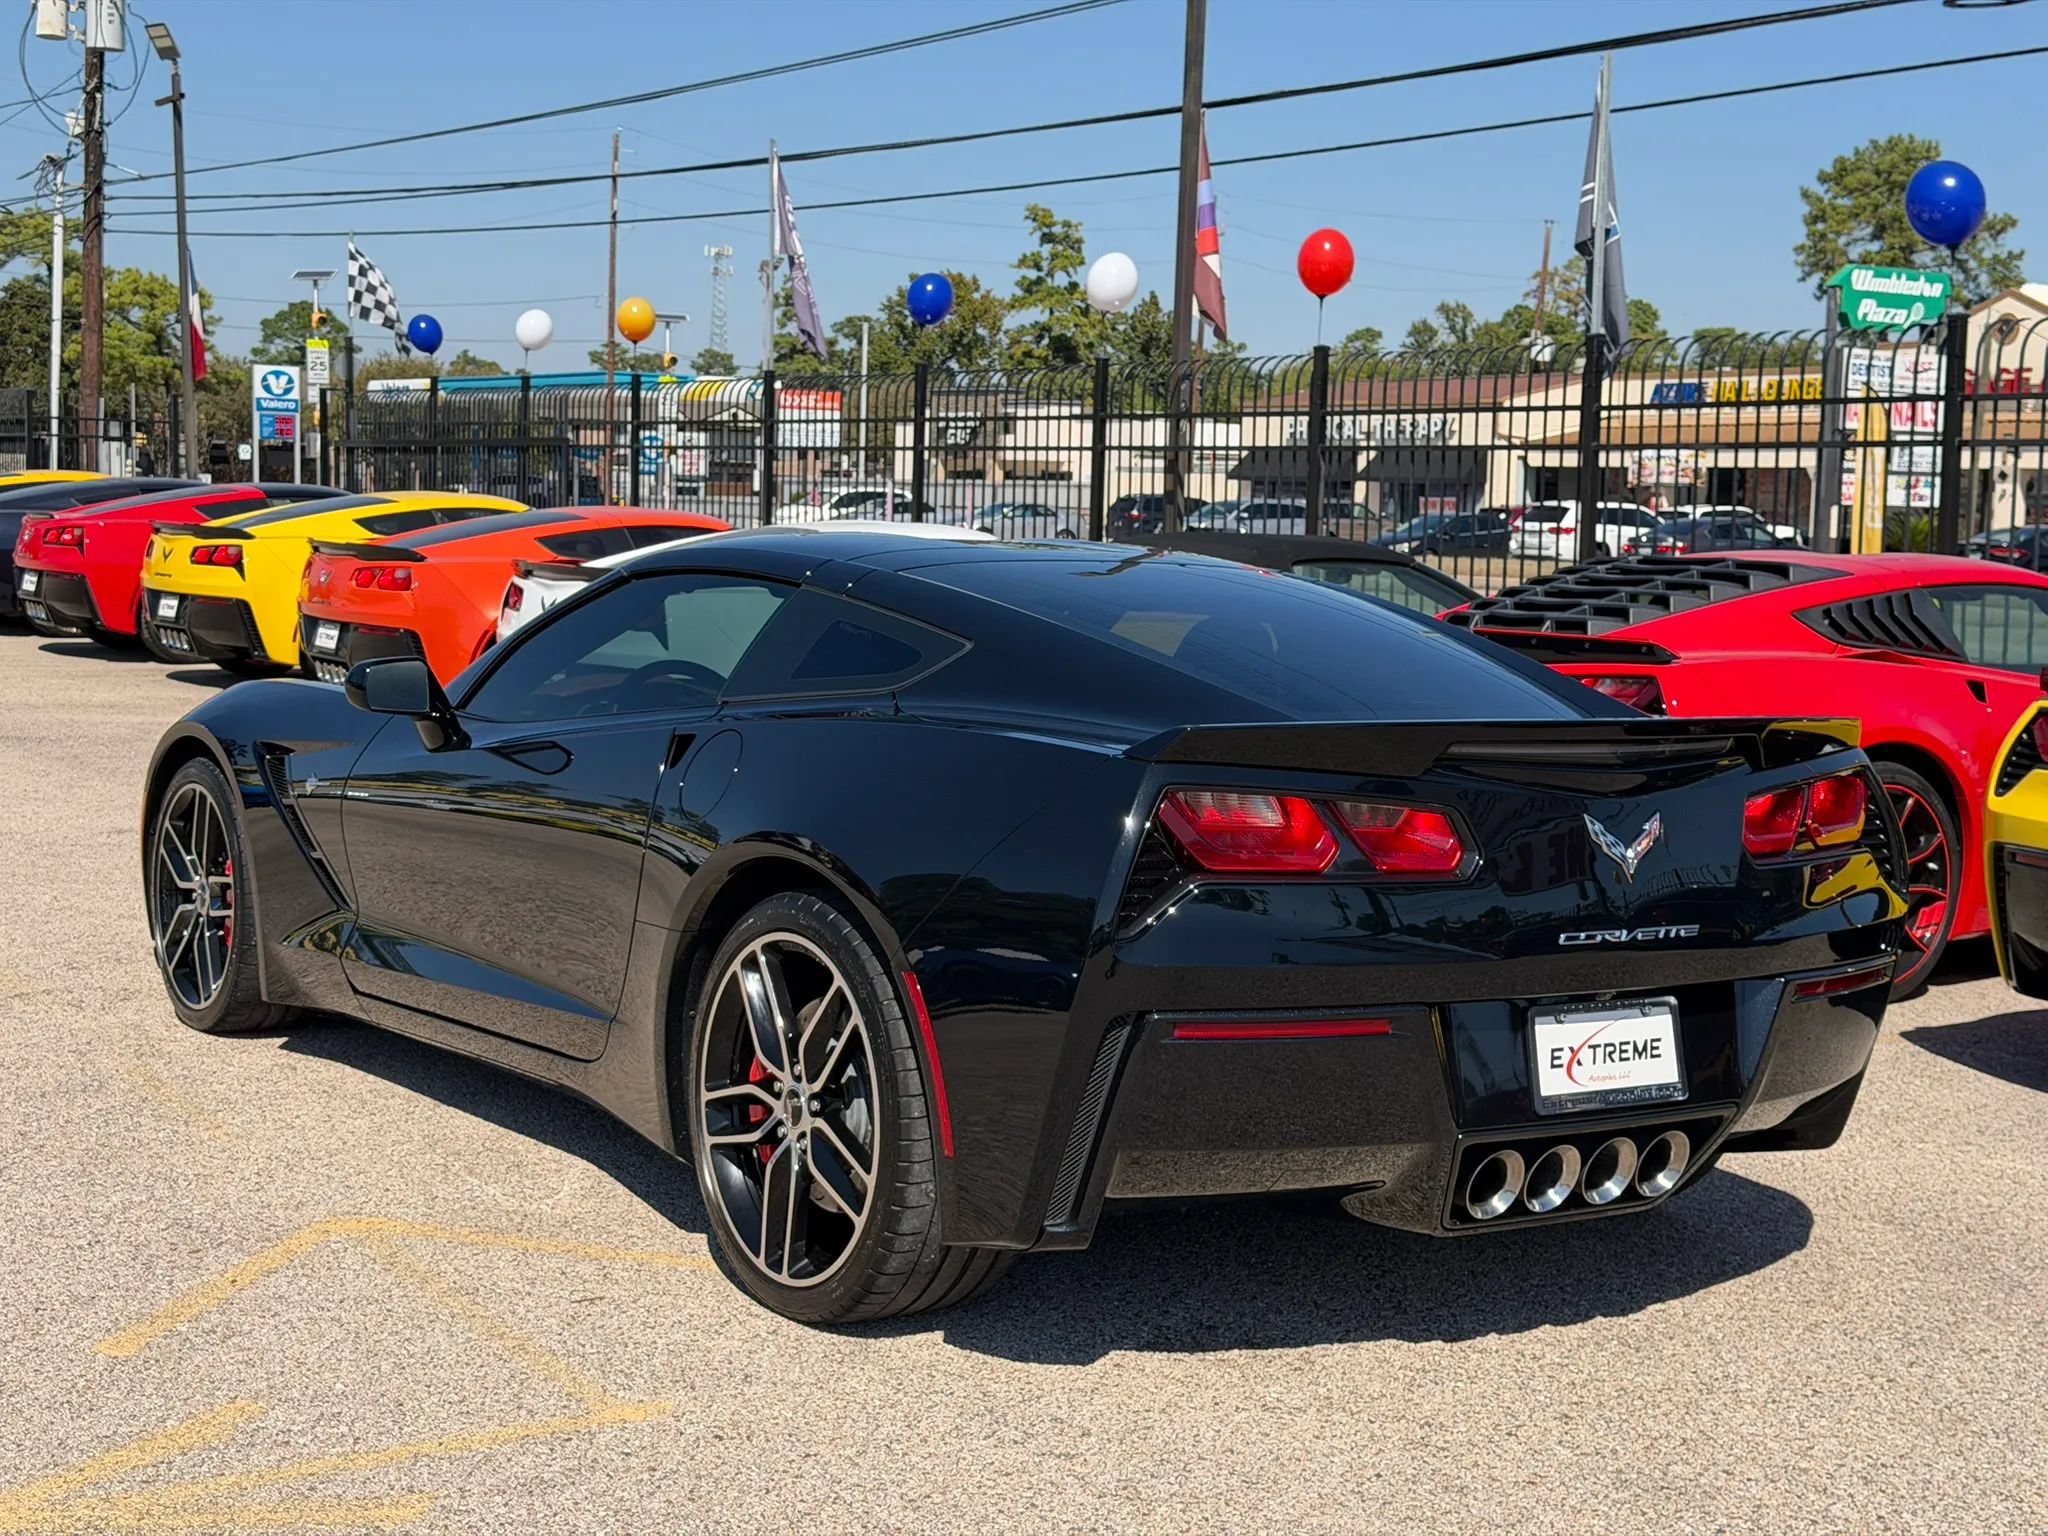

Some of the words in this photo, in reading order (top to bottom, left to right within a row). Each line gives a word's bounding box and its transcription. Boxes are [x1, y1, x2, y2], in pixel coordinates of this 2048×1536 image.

[1851, 268, 1944, 298] Wimbledon
[1857, 298, 1908, 324] Plaza
[310, 361, 328, 371] 25
[260, 399, 296, 409] Valero
[1286, 415, 1367, 440] PHICAL
[1558, 924, 1700, 946] CORVETTE
[1549, 1037, 1662, 1070] EXTREME
